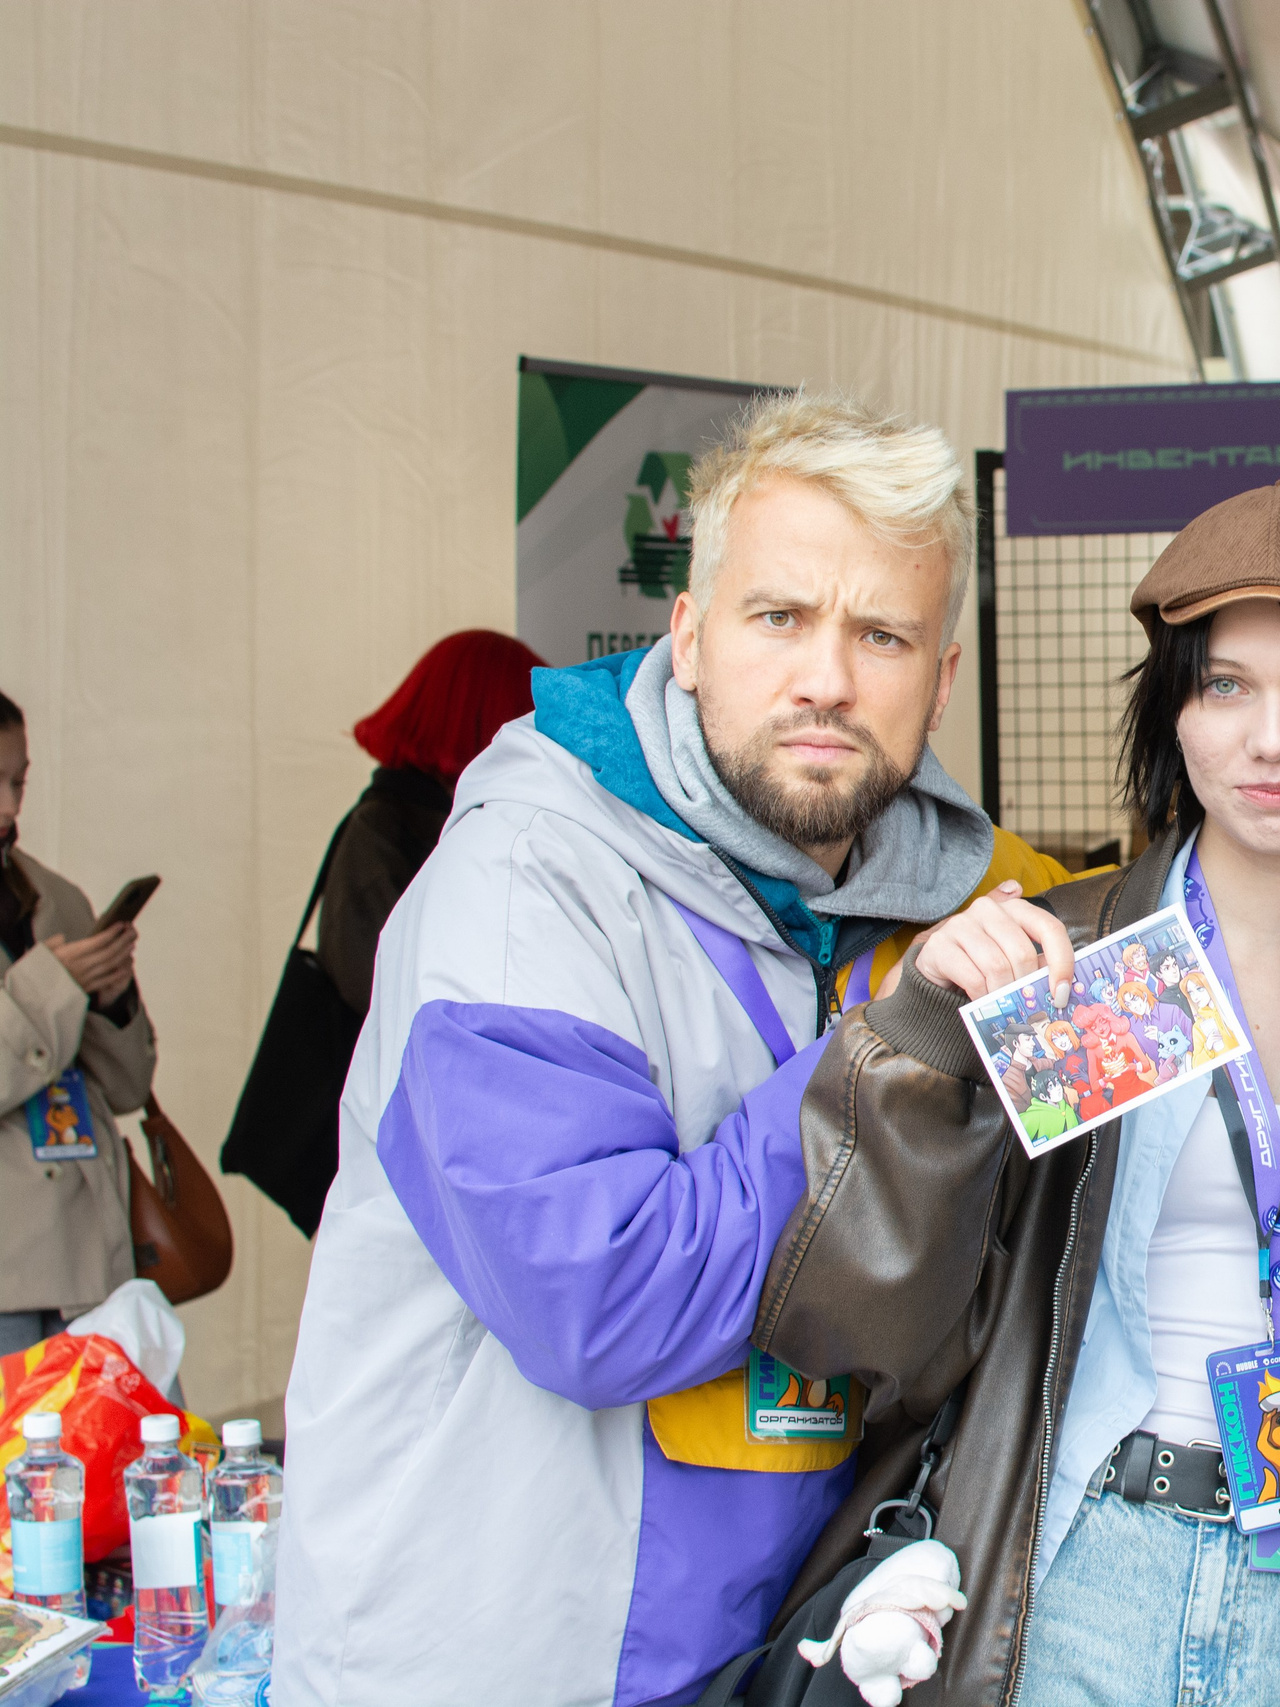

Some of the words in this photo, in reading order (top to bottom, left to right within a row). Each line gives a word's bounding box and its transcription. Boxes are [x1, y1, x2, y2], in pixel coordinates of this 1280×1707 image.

[1248, 1100, 1273, 1168] ДРУГ
[1236, 1360, 1258, 1372] BUBBLE
[759, 1415, 843, 1425] ОРГАНИЗАТОР
[1217, 1381, 1255, 1501] ГИККОН
